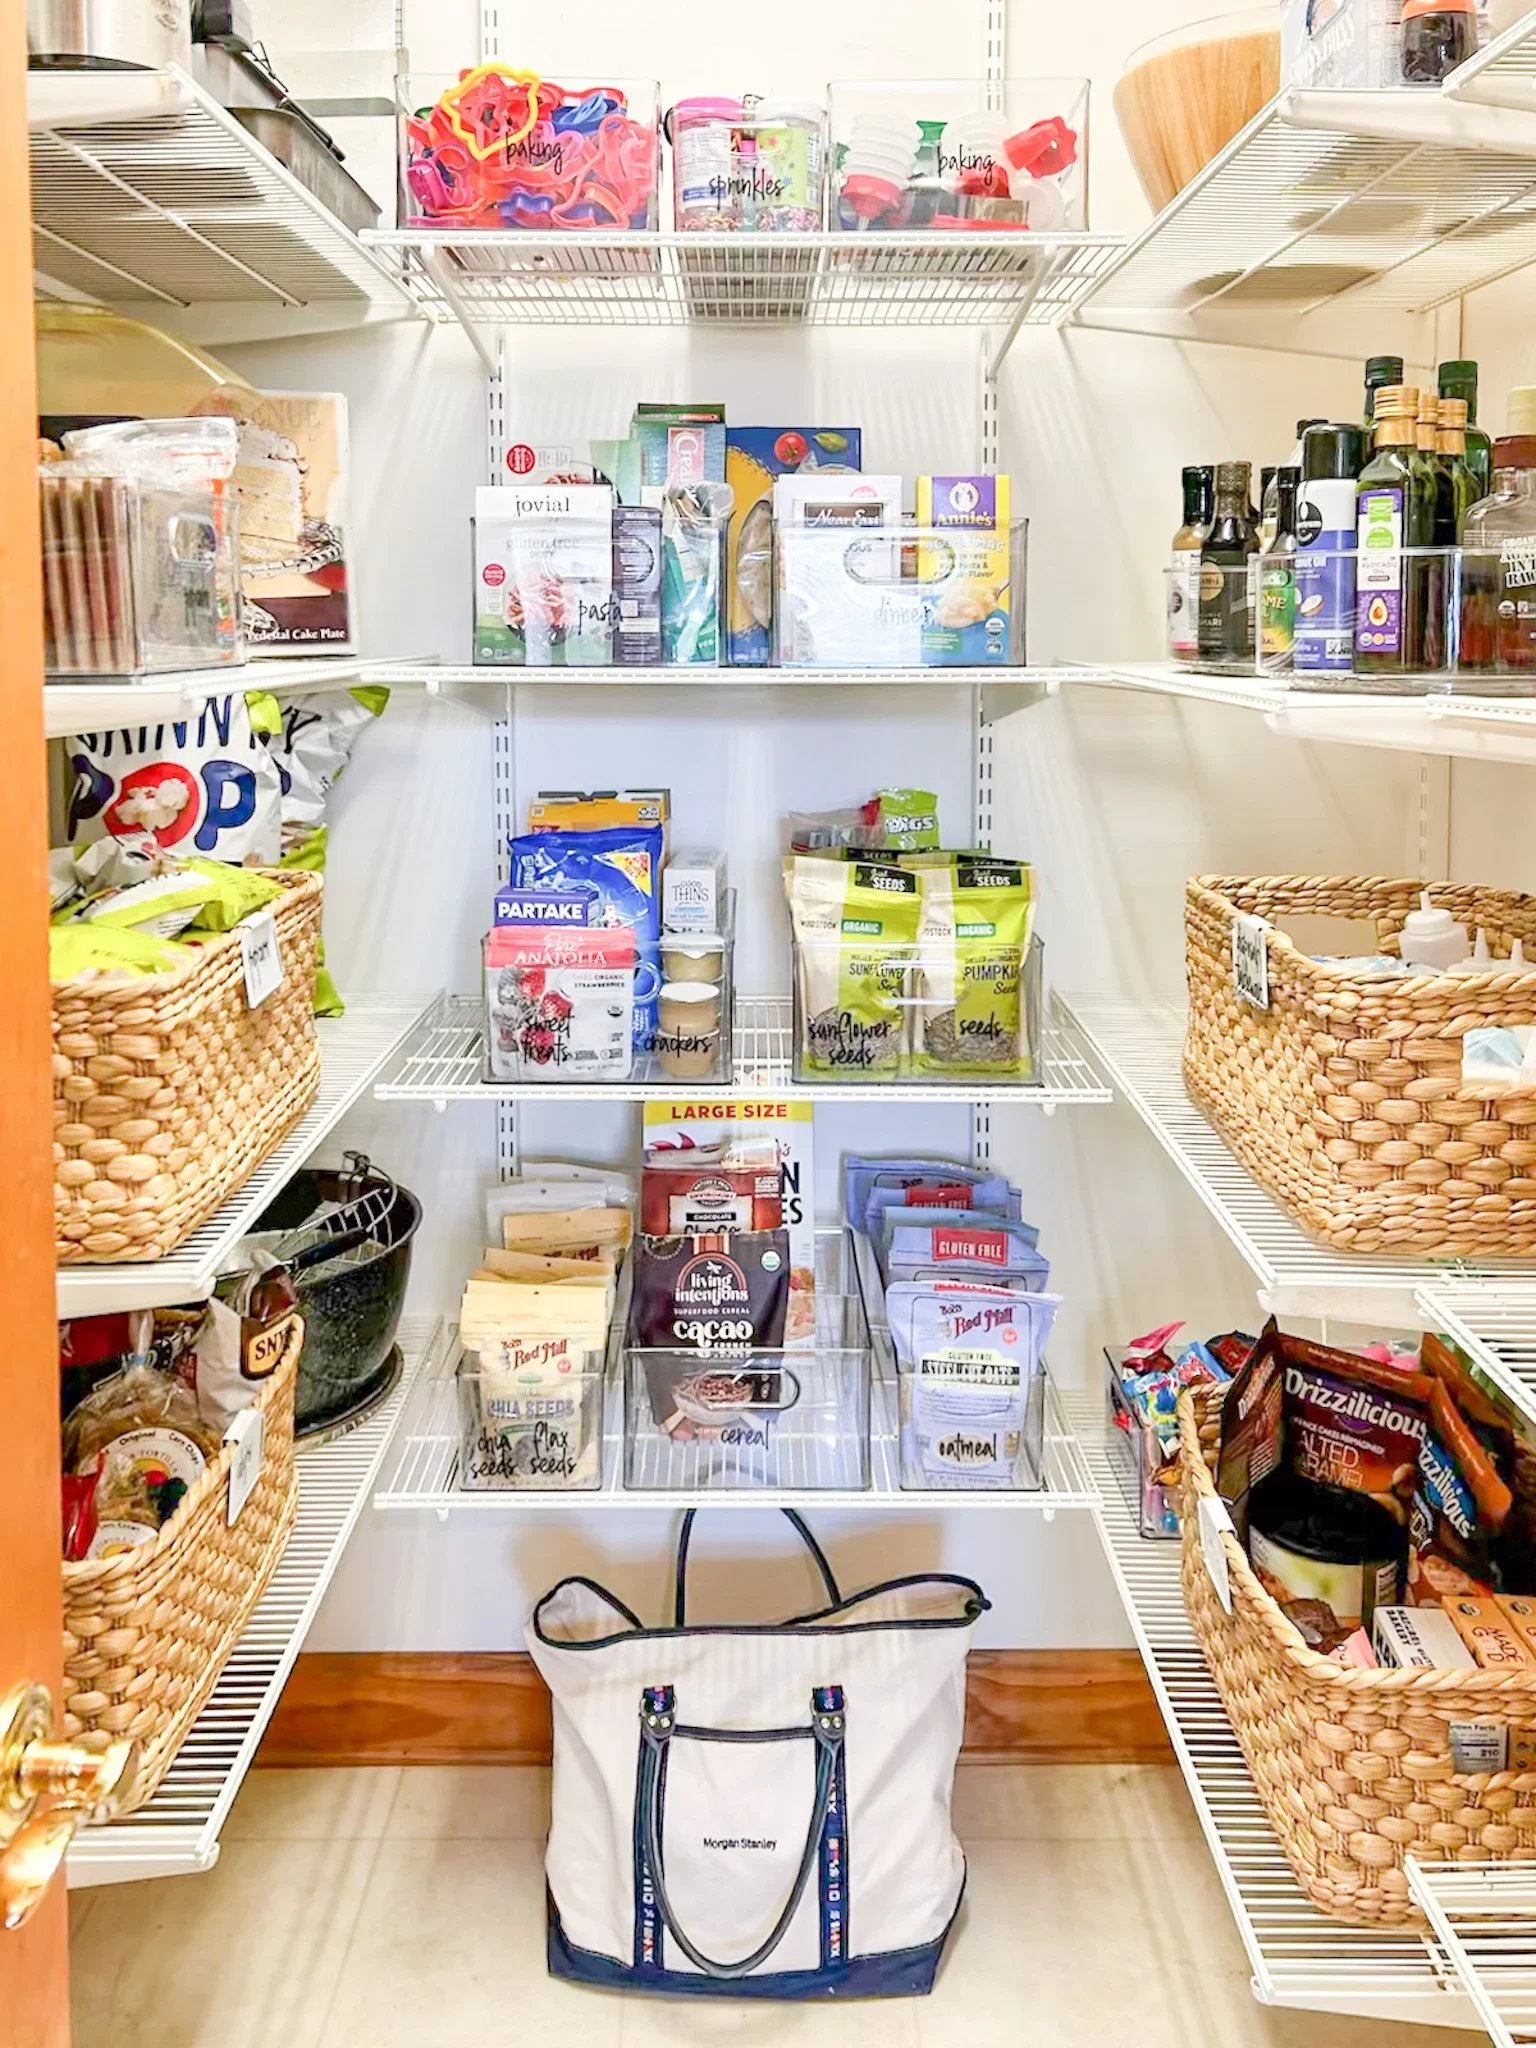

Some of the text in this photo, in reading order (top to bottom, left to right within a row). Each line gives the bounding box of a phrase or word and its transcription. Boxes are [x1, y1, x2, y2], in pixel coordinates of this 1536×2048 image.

[505, 131, 565, 175] baking
[937, 144, 996, 187] baking
[709, 167, 786, 211] sprinkles
[515, 495, 570, 517] jovial
[937, 511, 994, 527] Annie's
[577, 593, 624, 636] pasta
[292, 627, 318, 640] Cake
[67, 754, 257, 851] POP
[671, 884, 709, 902] THINS
[872, 876, 906, 892] SEEDS
[976, 875, 1011, 887] SEEDS
[498, 903, 584, 919] PARTAKE
[842, 921, 881, 933] ORGANIC
[957, 924, 994, 936] ORGANIC
[514, 950, 608, 966] ANATOLIA
[808, 1012, 893, 1047] sunflower
[959, 1012, 1004, 1042] seeds
[519, 1035, 573, 1067] treats
[644, 1026, 713, 1058] crackers
[829, 1038, 876, 1070] seeds
[671, 1104, 788, 1119] LARGE SIZE
[938, 1240, 1002, 1258] GLUTEN FREE
[690, 1273, 733, 1291] living
[674, 1287, 750, 1307] intentions
[673, 1307, 750, 1316] SUPERFOOD CEREAL
[954, 1311, 982, 1340] Red
[672, 1320, 754, 1348] cacao
[513, 1345, 540, 1371] Red
[533, 1420, 569, 1459] flax
[720, 1419, 769, 1450] cereal
[938, 1432, 997, 1462] oatmeal
[470, 1449, 517, 1478] seeds
[530, 1447, 577, 1478] seeds
[1299, 1430, 1360, 1469] ALTED
[703, 1837, 778, 1852] Morgan Stanley
